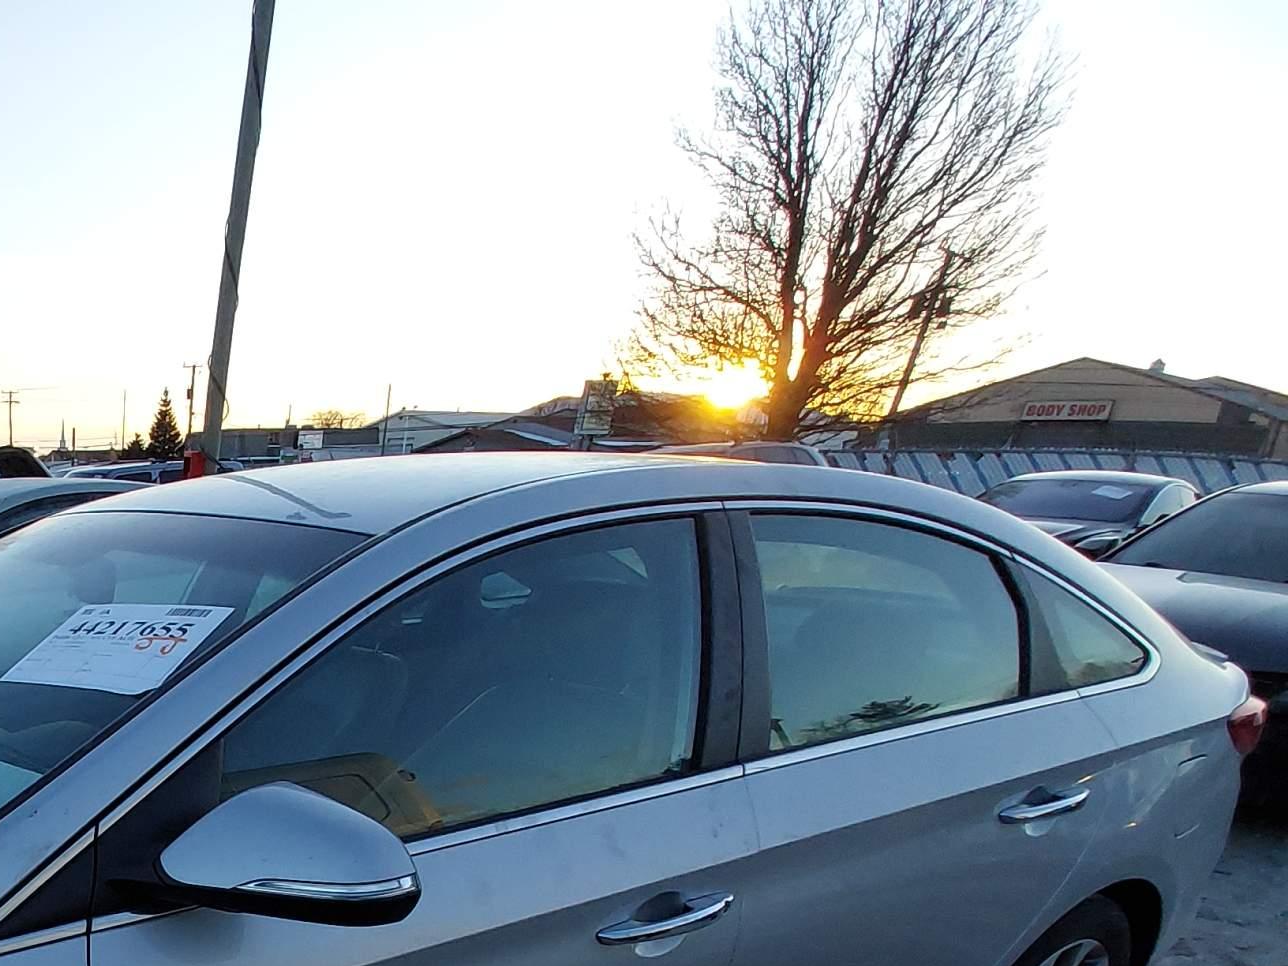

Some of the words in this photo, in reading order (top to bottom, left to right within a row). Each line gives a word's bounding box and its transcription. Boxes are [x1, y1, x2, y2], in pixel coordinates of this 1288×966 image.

[1025, 404, 1065, 417] BODY
[1067, 404, 1107, 417] SHOP
[69, 620, 195, 638] 44217655
